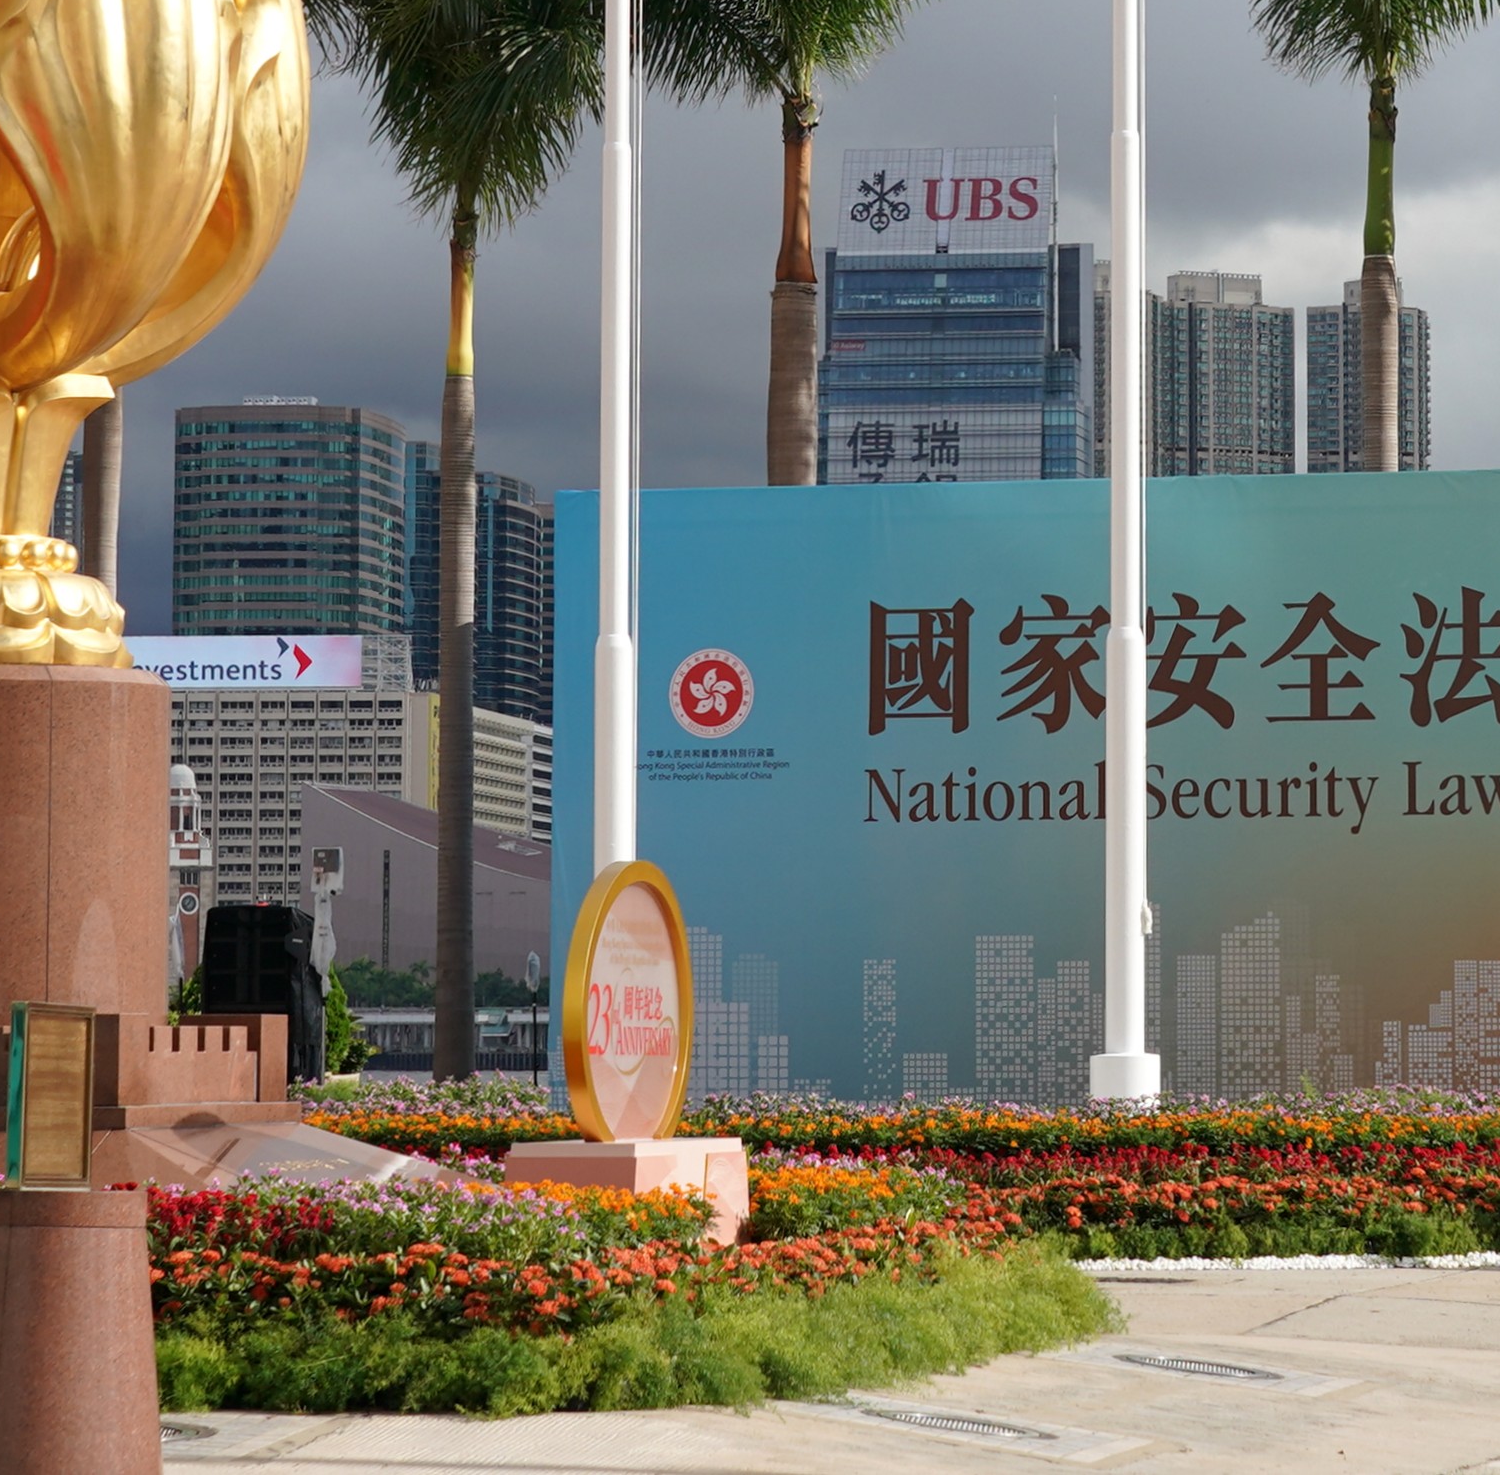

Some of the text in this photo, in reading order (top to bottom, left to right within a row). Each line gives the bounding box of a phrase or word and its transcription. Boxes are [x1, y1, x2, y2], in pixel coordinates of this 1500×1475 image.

[923, 177, 1040, 221] UBS
[638, 760, 790, 771] ong Kong Special Administrative Region
[706, 772, 740, 782] Republic
[750, 771, 772, 781] China
[863, 760, 1106, 823] National
[1146, 761, 1379, 834] Security
[623, 986, 664, 1020] 周年紀念
